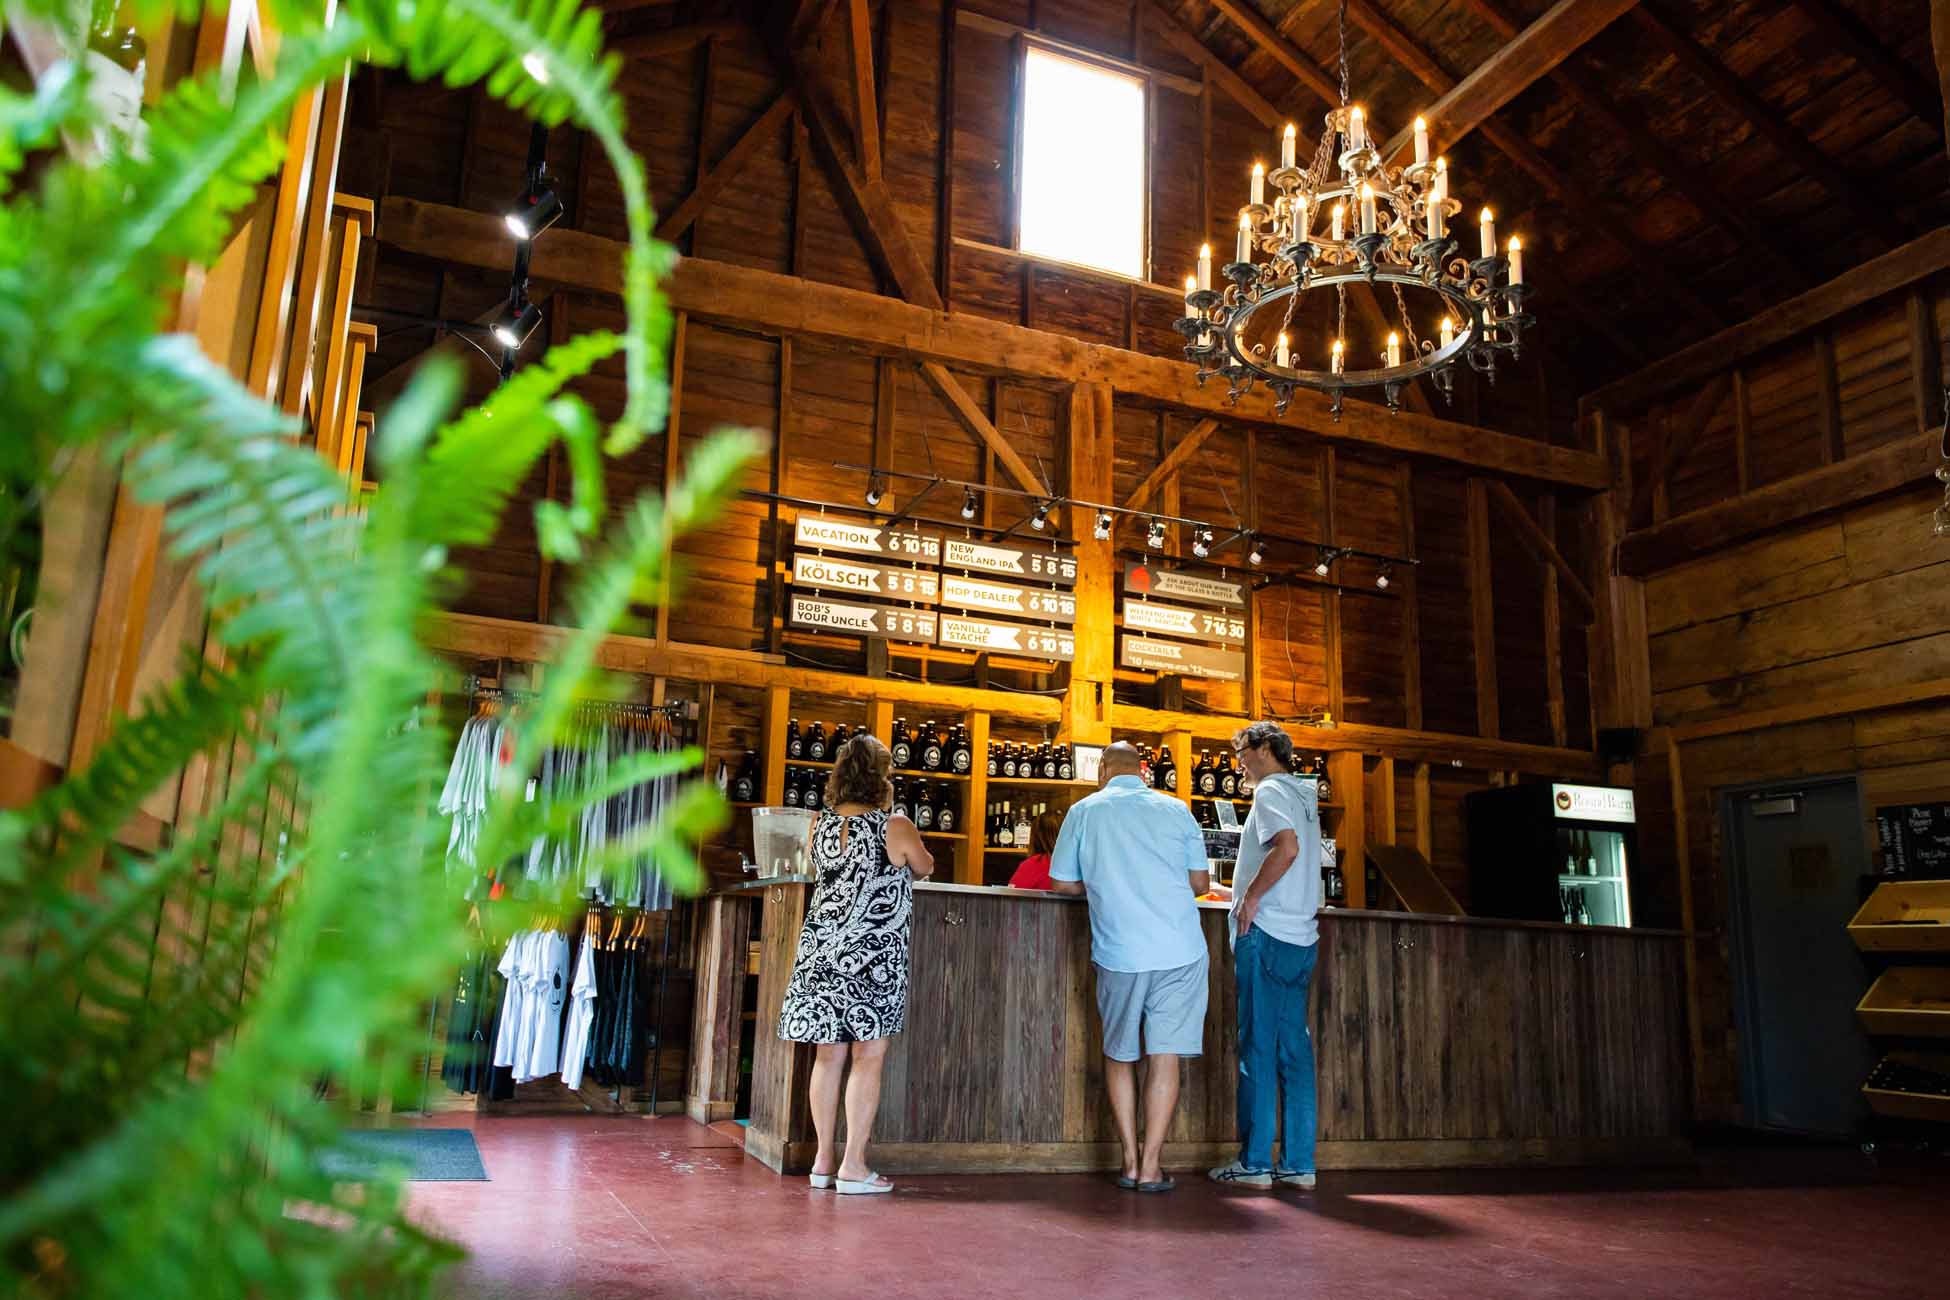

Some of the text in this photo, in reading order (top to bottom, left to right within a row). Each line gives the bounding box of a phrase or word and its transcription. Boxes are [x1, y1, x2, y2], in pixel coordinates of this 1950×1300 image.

[802, 525, 940, 556] VACATION 6 10 18
[950, 543, 974, 553] NEW
[950, 552, 1014, 569] ENGLAND IPA
[1031, 558, 1076, 578] 5 8 15
[801, 563, 937, 596] KÖLSCH 5 8 15
[1180, 578, 1199, 586] ABOUT
[797, 602, 831, 613] BOB'S
[946, 585, 970, 597] HOP
[973, 588, 1015, 603] DEALER
[1029, 596, 1040, 610] 6
[1041, 598, 1058, 613] 10
[1059, 601, 1075, 615] 18
[797, 611, 868, 628] YOUR UNCLE
[886, 616, 933, 636] 5 8 15
[946, 622, 991, 635] VANILLA
[1203, 619, 1212, 633] 7
[1212, 622, 1227, 636] 16
[1228, 625, 1245, 639] 30
[1028, 636, 1038, 650] 6
[1040, 638, 1057, 653] 10
